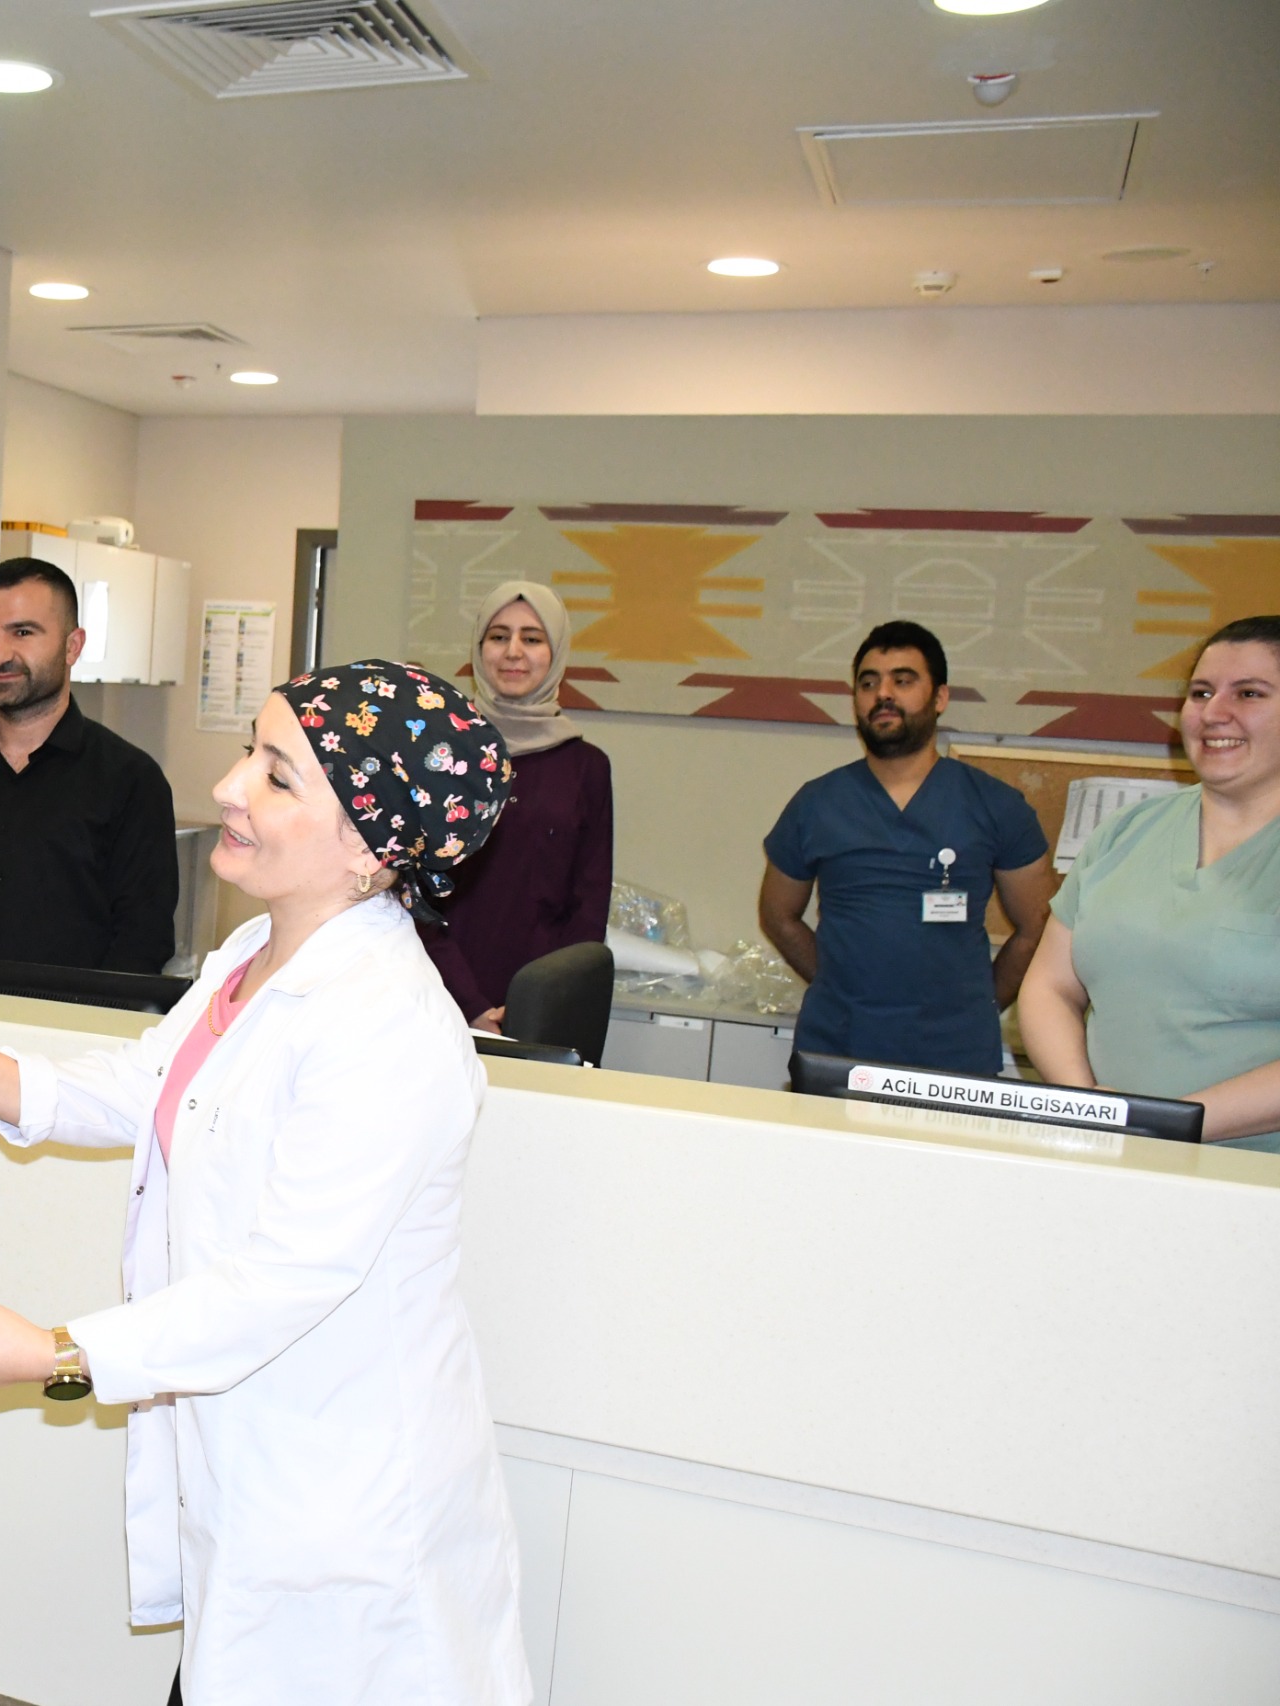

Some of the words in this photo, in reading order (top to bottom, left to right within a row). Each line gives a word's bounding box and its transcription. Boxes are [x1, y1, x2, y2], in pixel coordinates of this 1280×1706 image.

[881, 1077, 922, 1096] ACİL
[928, 1083, 994, 1104] DURUM
[1000, 1091, 1117, 1120] BİLGİSAYARI
